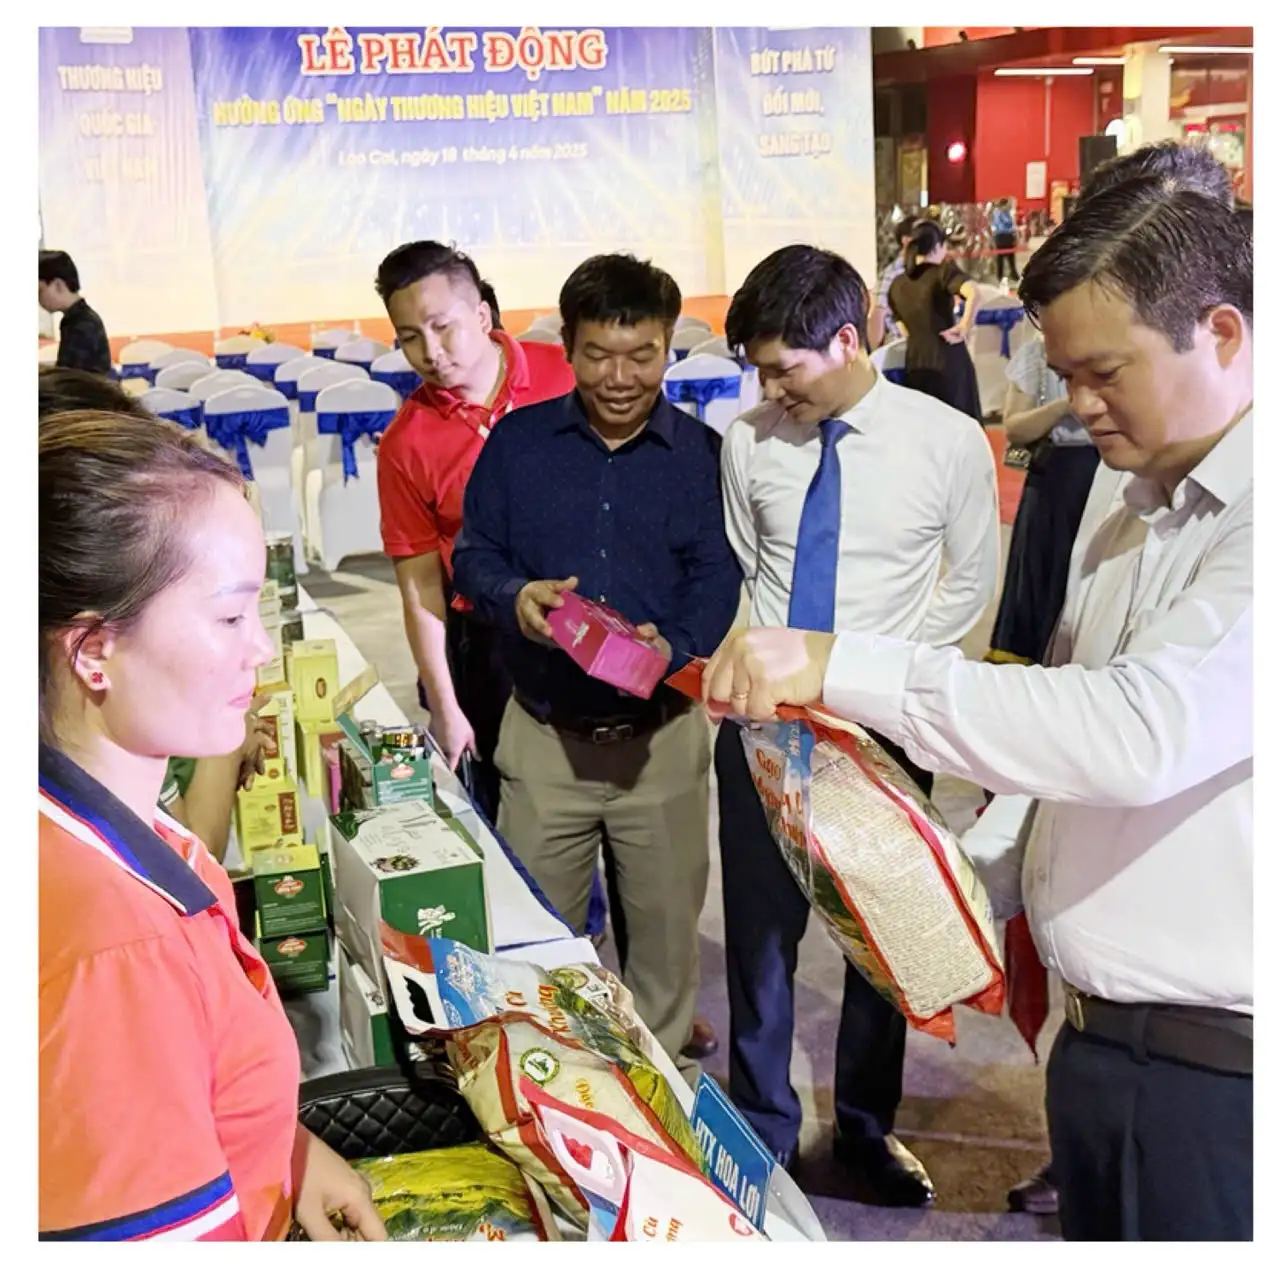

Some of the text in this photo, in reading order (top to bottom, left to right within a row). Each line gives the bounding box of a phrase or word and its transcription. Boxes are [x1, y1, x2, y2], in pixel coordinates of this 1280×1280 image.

[358, 27, 476, 74] PHÁT
[483, 27, 607, 80] ĐỘNG
[650, 89, 692, 113] 2025
[508, 145, 519, 160] 4
[695, 1116, 717, 1168] HTX
[715, 1144, 740, 1199] HOA
